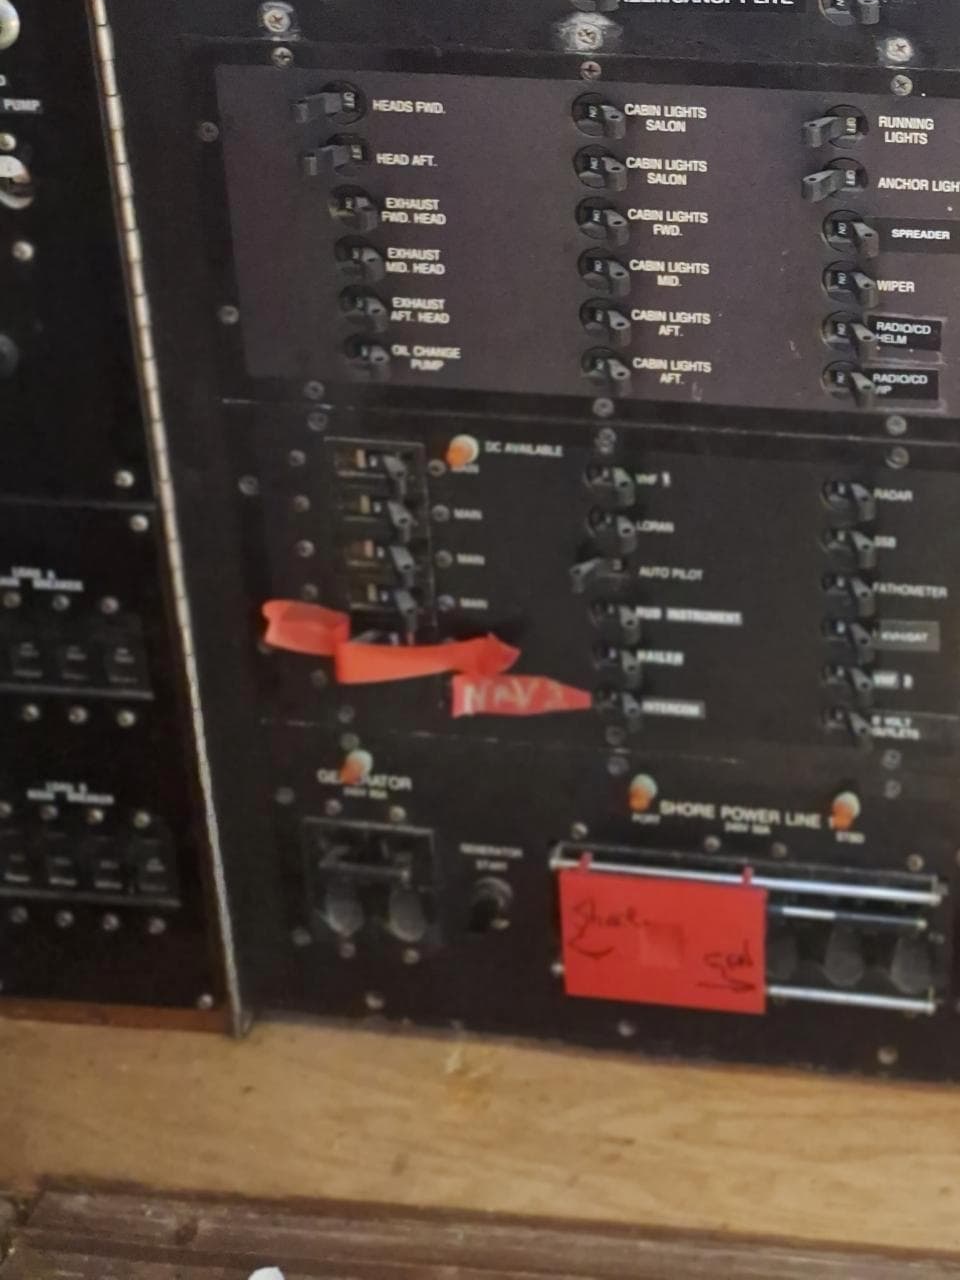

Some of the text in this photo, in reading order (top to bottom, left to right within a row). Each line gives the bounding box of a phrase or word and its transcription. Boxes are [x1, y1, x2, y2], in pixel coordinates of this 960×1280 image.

[4, 99, 40, 111] PUMP
[373, 100, 446, 114] HEADS FWD.
[624, 103, 707, 119] CABIN LIGHTS
[646, 120, 686, 133] SALON
[879, 116, 934, 130] RUNNING
[885, 131, 928, 144] LIGHTS
[377, 154, 438, 167] HEAD AFT.
[626, 157, 708, 173] CABIN LIGHTS
[647, 173, 687, 186] SALON
[878, 177, 929, 191] ANCHOR
[385, 198, 439, 211] EXHAUST
[414, 213, 446, 225] HEAD
[627, 209, 708, 224] CABIN LIGHTS
[653, 224, 683, 236] FWD.
[891, 229, 950, 240] SPREADER
[388, 248, 440, 261] EXHAUST
[413, 263, 445, 275] HEAD
[629, 259, 710, 276] CABIN LIGHTS
[877, 280, 915, 293] WIPER
[392, 297, 445, 310] EXHAUST
[418, 312, 450, 324] HEAD
[631, 310, 711, 326] CABIN LIGHTS
[876, 322, 931, 335] RADIO/CD
[413, 346, 461, 359] CHANGE
[410, 360, 444, 371] PUMP
[633, 358, 712, 373] CABIN LIGHTS
[873, 373, 928, 385] RADIO/CD
[874, 489, 912, 501] RADAR
[639, 566, 703, 580] AUTO PILOT
[873, 583, 947, 598] FATHOMETER
[660, 800, 820, 828] SHORE POWER LINE
